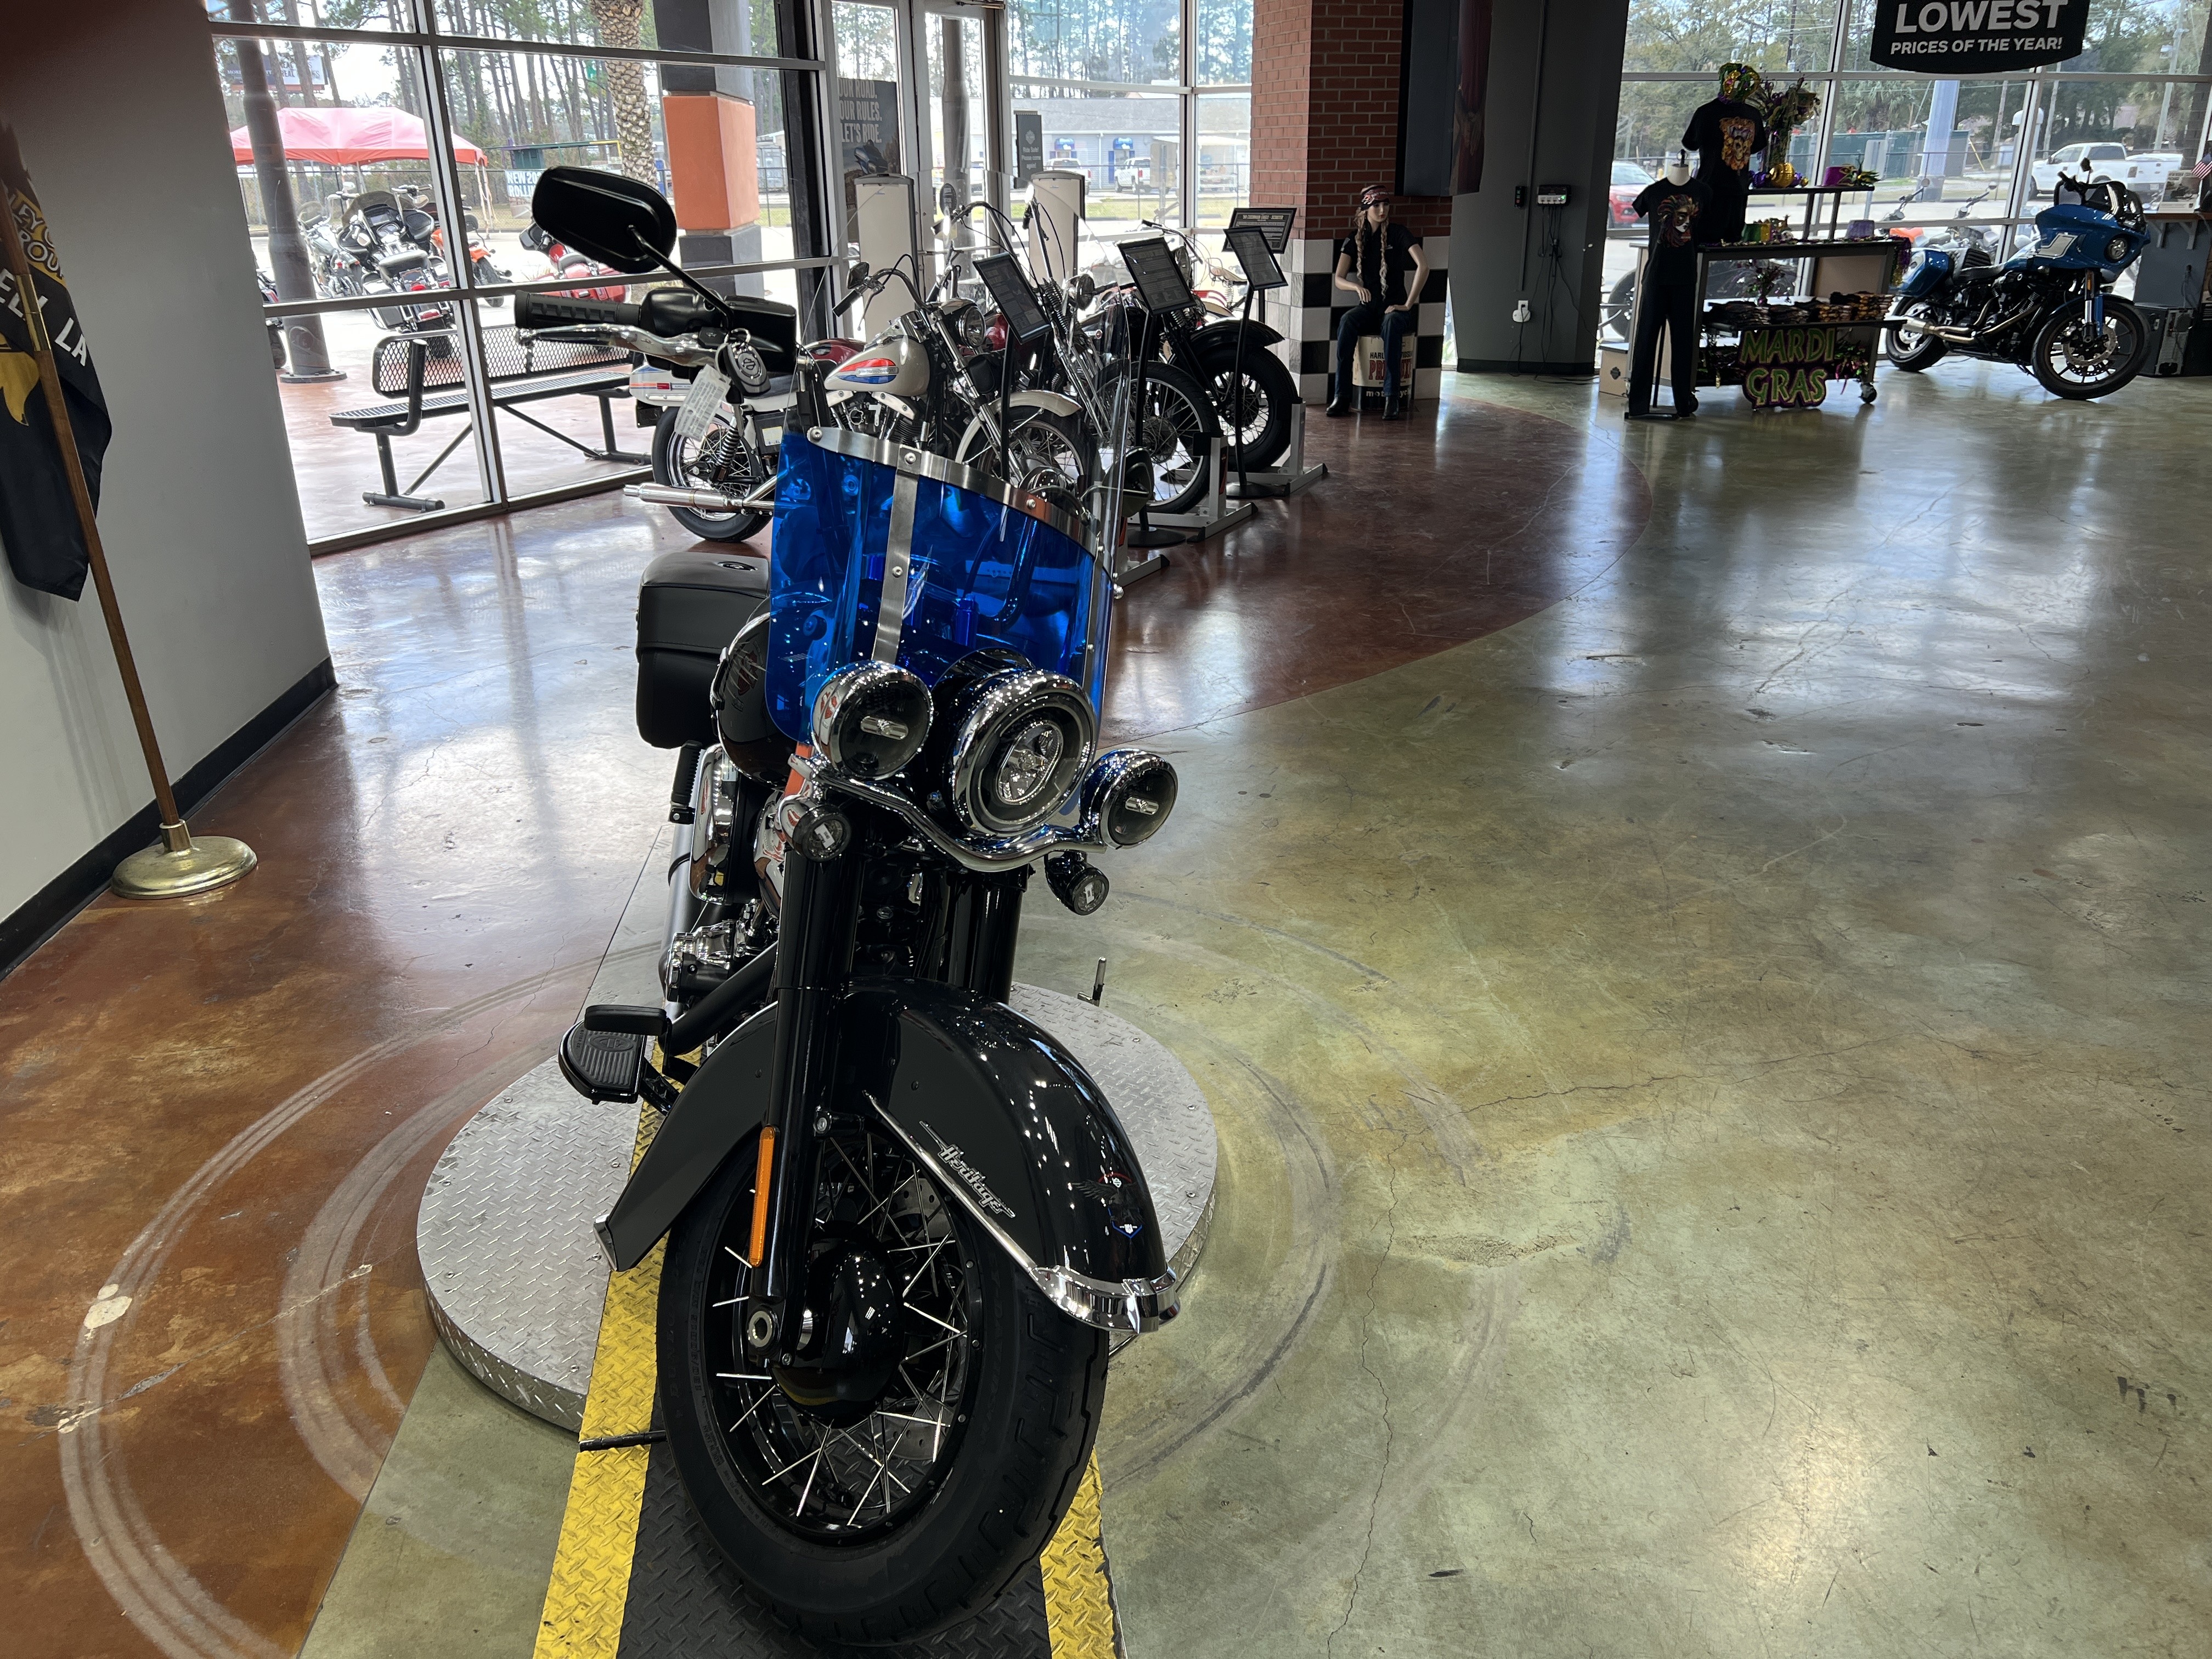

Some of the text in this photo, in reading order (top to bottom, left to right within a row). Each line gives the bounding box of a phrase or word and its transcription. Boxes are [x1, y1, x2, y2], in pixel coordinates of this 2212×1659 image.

[1895, 0, 2068, 33] LOWEST
[1891, 37, 2063, 54] PRICES OF THE YEAR!
[855, 80, 878, 99] ROAD.
[856, 101, 882, 121] RULES.
[841, 123, 882, 143] LET'S RIDE.
[505, 172, 526, 184] NEW
[55, 317, 87, 366] LA
[1740, 328, 1836, 364] MARDI
[1747, 367, 1828, 405] GRAS
[934, 1138, 1007, 1215] Heritage
